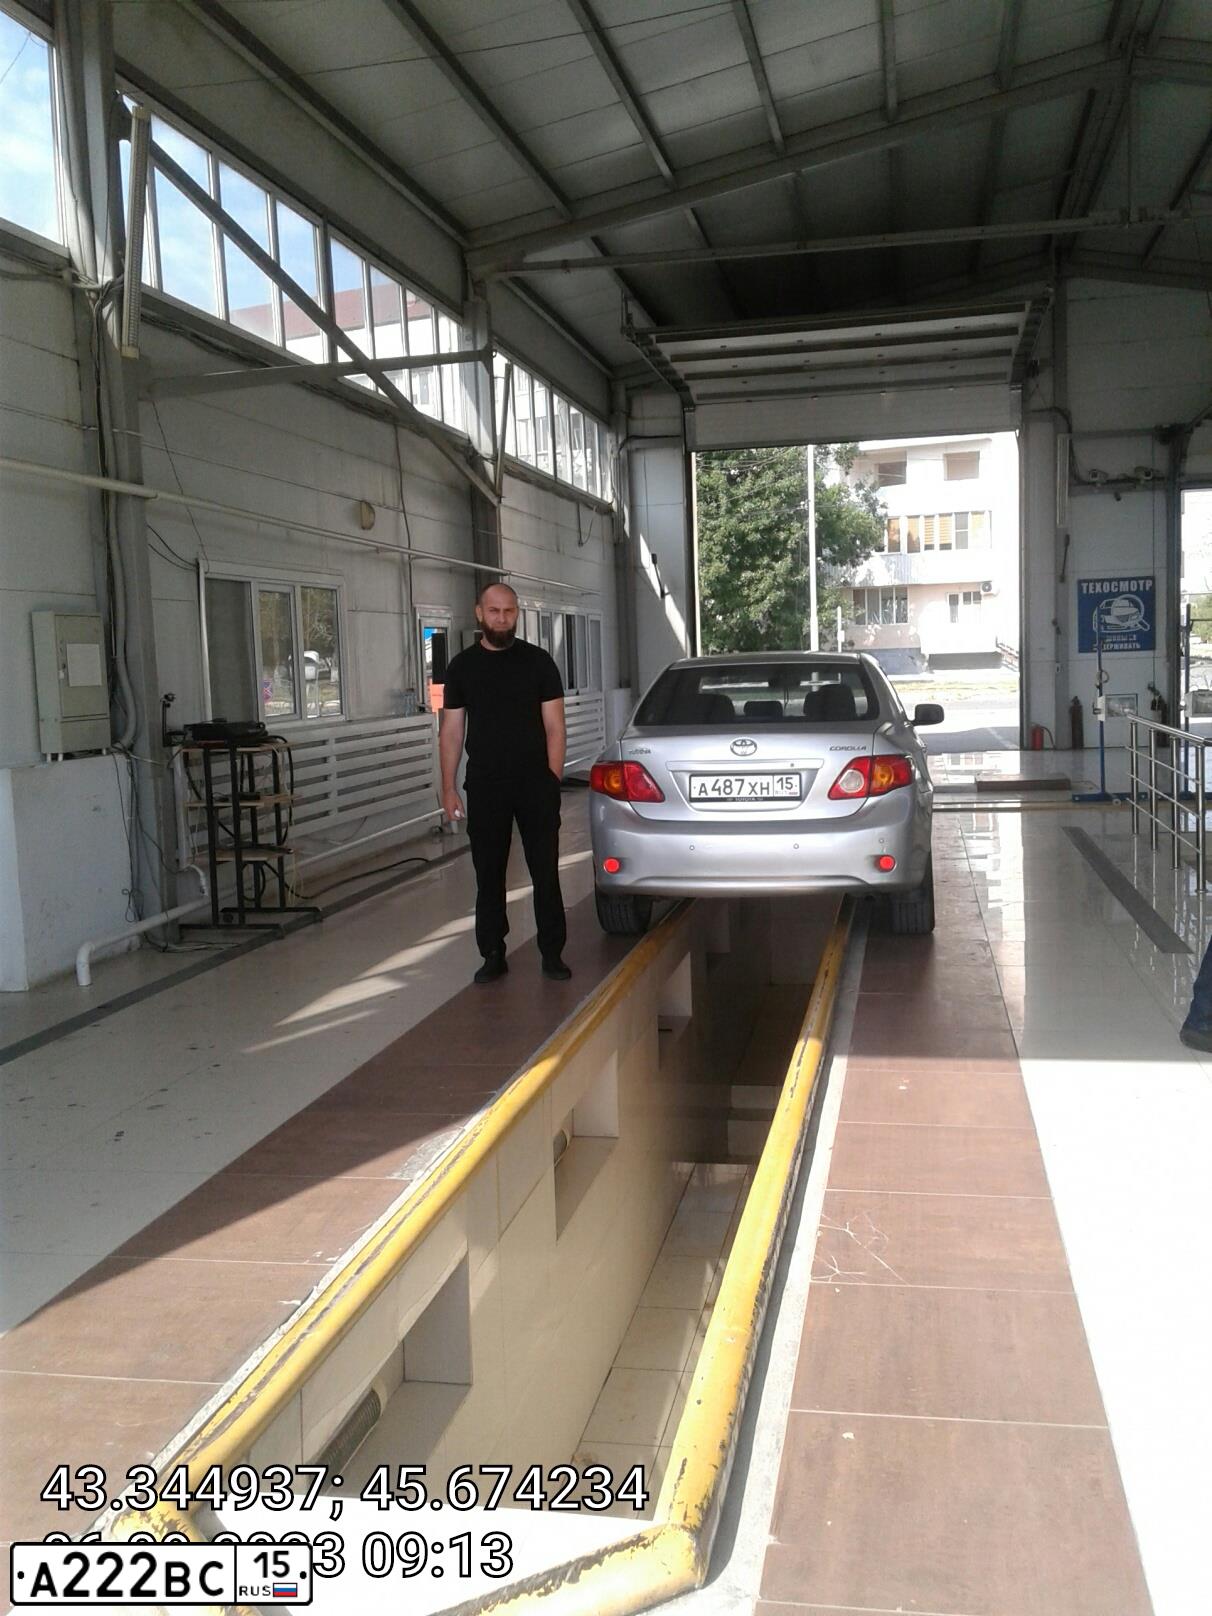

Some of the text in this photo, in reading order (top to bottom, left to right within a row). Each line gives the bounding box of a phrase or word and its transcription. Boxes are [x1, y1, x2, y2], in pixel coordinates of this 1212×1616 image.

[1081, 580, 1153, 594] ТЕХОСМОТР
[698, 777, 793, 796] А487ХН 15
